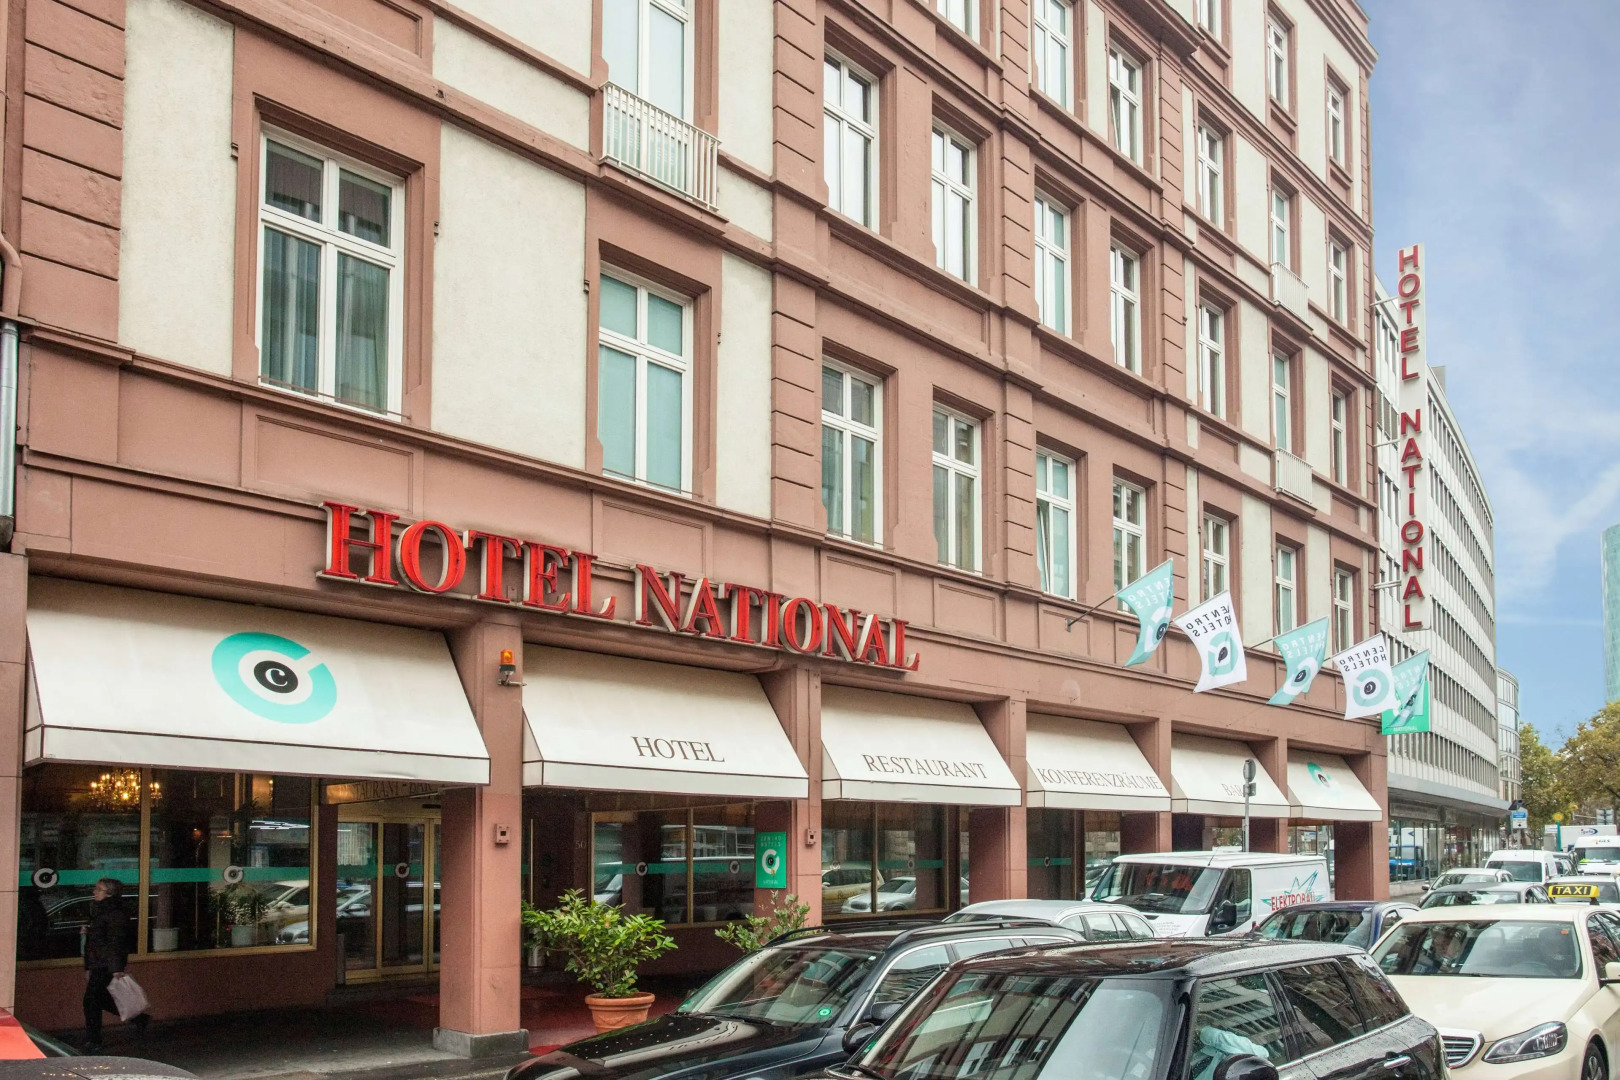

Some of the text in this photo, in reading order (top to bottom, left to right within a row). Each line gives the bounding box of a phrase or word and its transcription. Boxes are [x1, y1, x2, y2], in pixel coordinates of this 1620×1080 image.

[1398, 245, 1424, 628] HOTEL NATIONAL
[316, 500, 920, 672] HOTEL NATIONAL
[631, 736, 725, 763] HOTEL
[861, 754, 988, 780] RESTAURANT
[1036, 768, 1163, 791] KONFERENZRÄUME
[1221, 783, 1244, 798] BAR
[1556, 885, 1589, 895] TAXI
